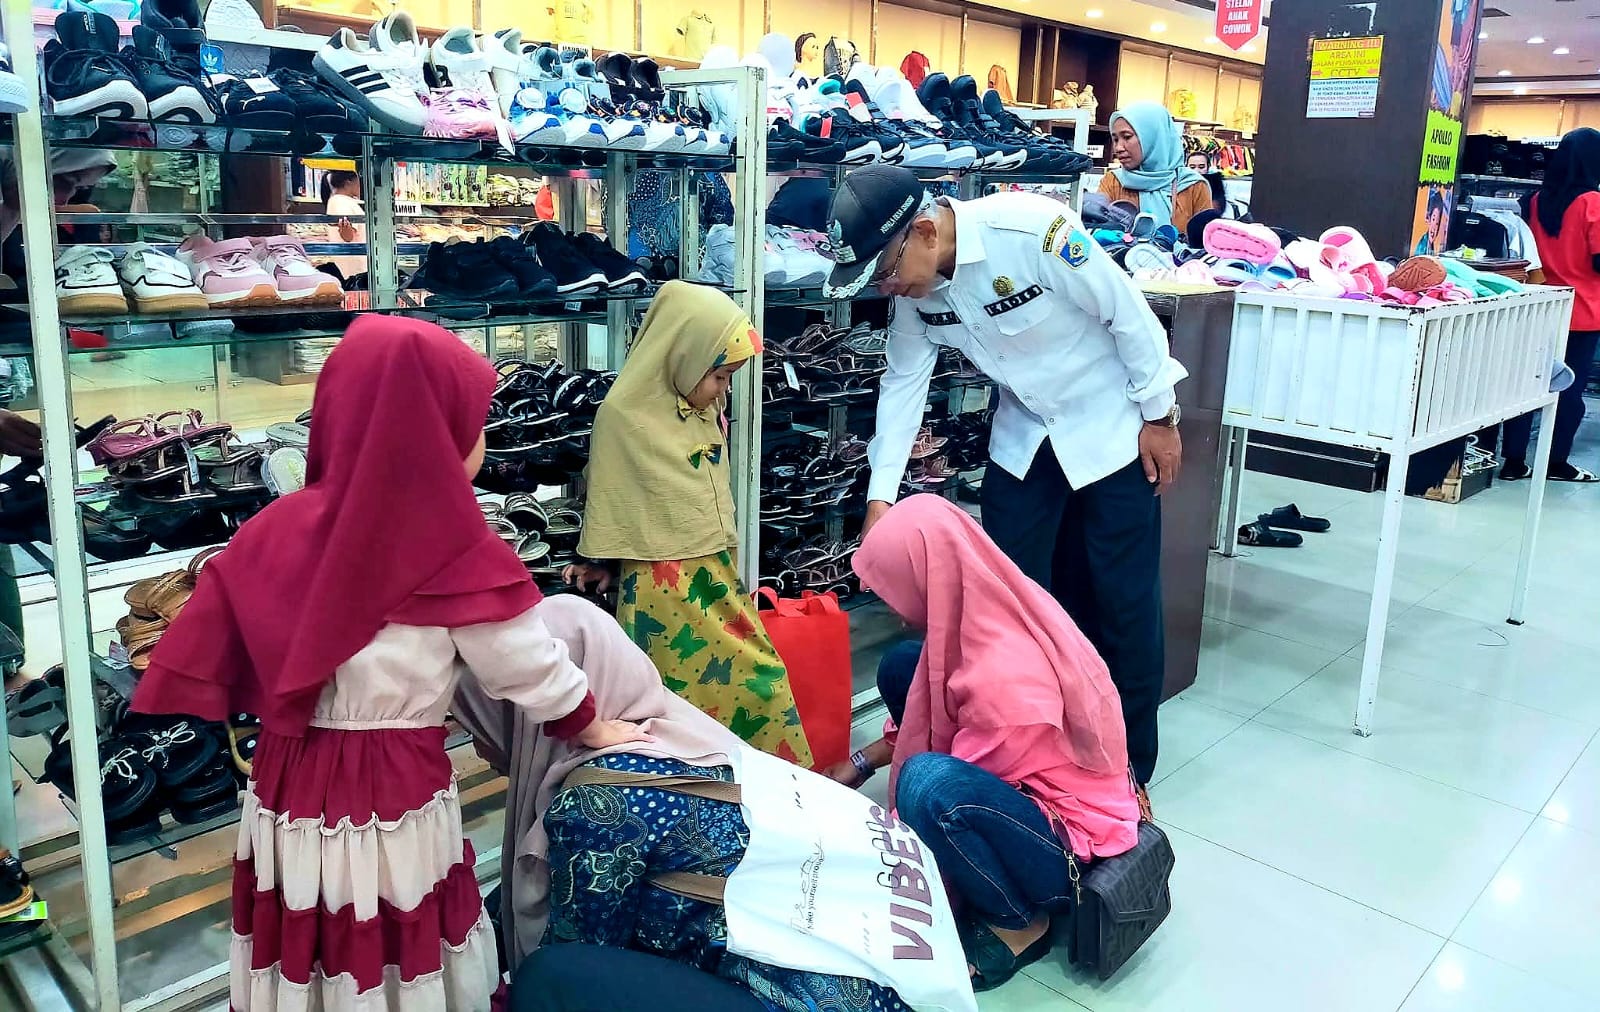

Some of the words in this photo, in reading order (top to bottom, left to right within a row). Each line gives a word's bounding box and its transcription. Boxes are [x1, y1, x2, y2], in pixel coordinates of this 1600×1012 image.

[1225, 0, 1253, 8] STELAN
[1228, 11, 1249, 21] ANAK
[1223, 24, 1251, 34] COWOK
[1318, 40, 1364, 50] WARNING
[1330, 51, 1351, 59] AREA
[1330, 68, 1361, 77] CCTV
[1431, 129, 1452, 146] APOLLO
[1426, 154, 1450, 171] FASHION
[869, 805, 934, 960] VIBES
